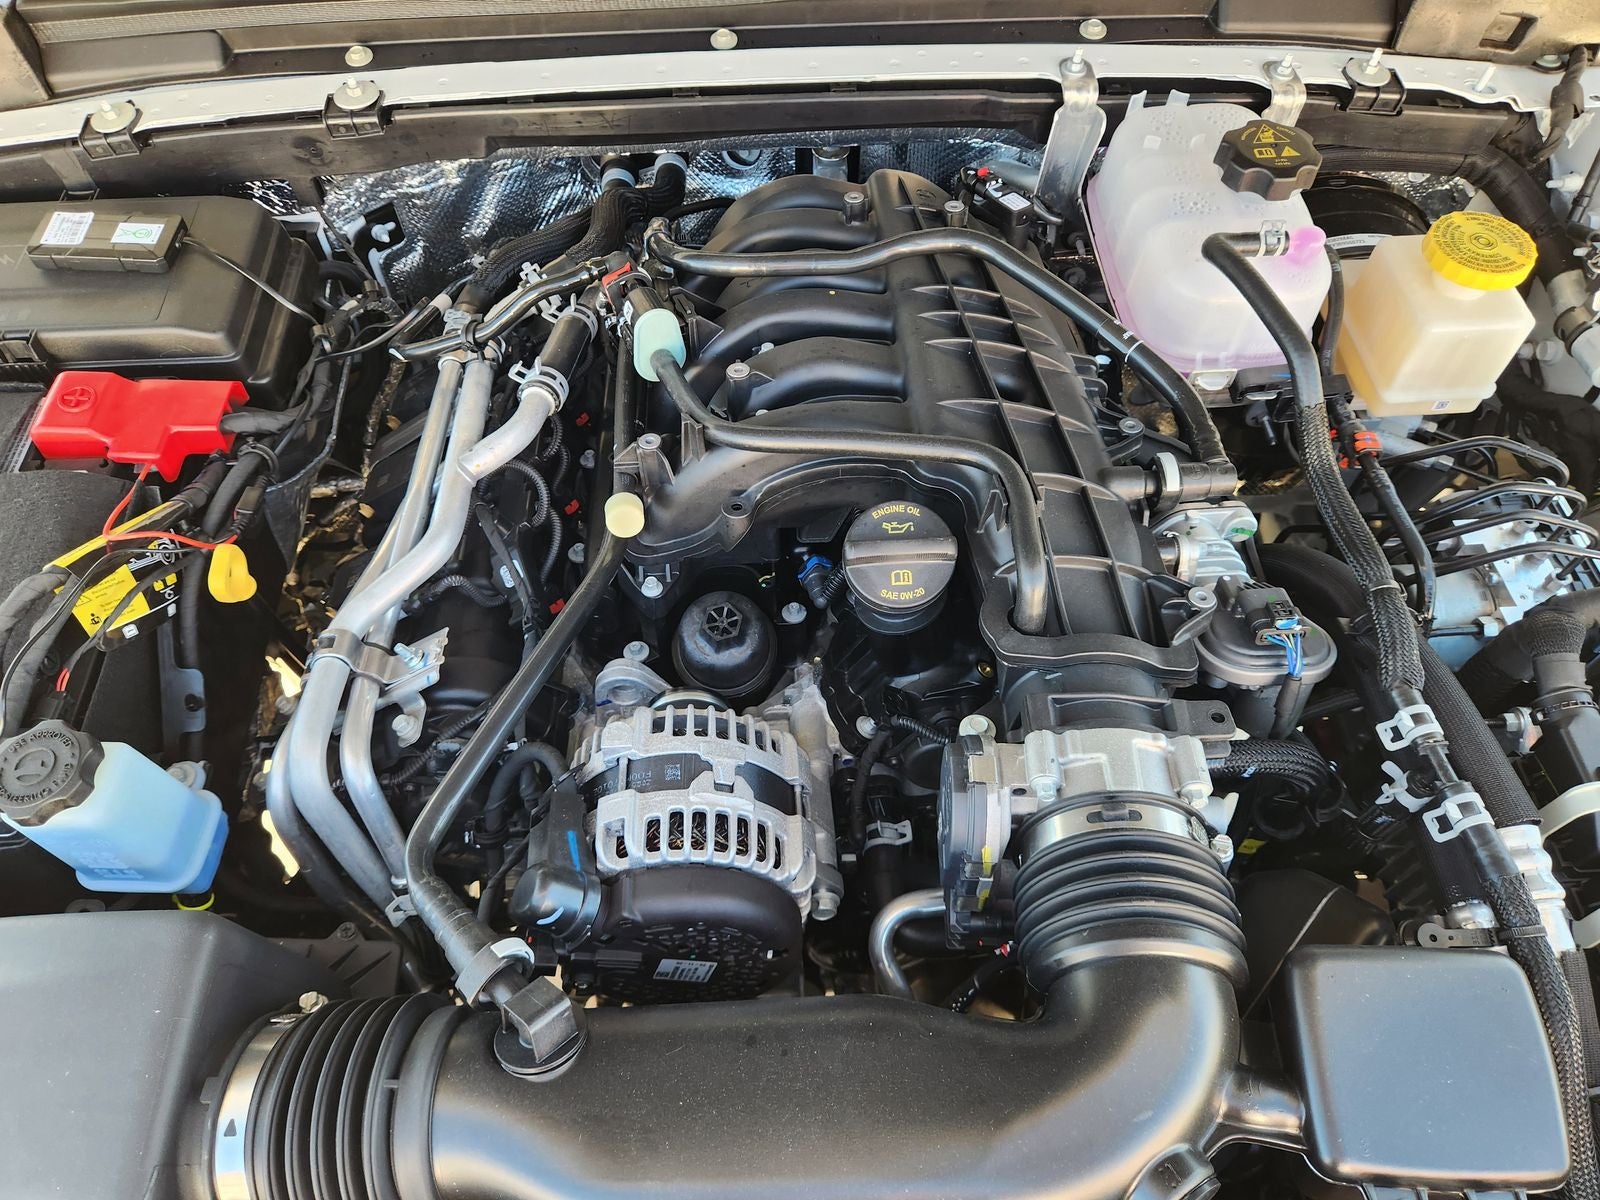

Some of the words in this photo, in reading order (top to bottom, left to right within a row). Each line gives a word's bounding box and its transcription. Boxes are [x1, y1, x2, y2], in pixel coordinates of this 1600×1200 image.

[872, 505, 905, 519] ENGINE
[907, 506, 921, 517] OIL
[880, 588, 899, 600] SAE
[900, 587, 925, 600] 0W-20
[7, 738, 28, 753] USE
